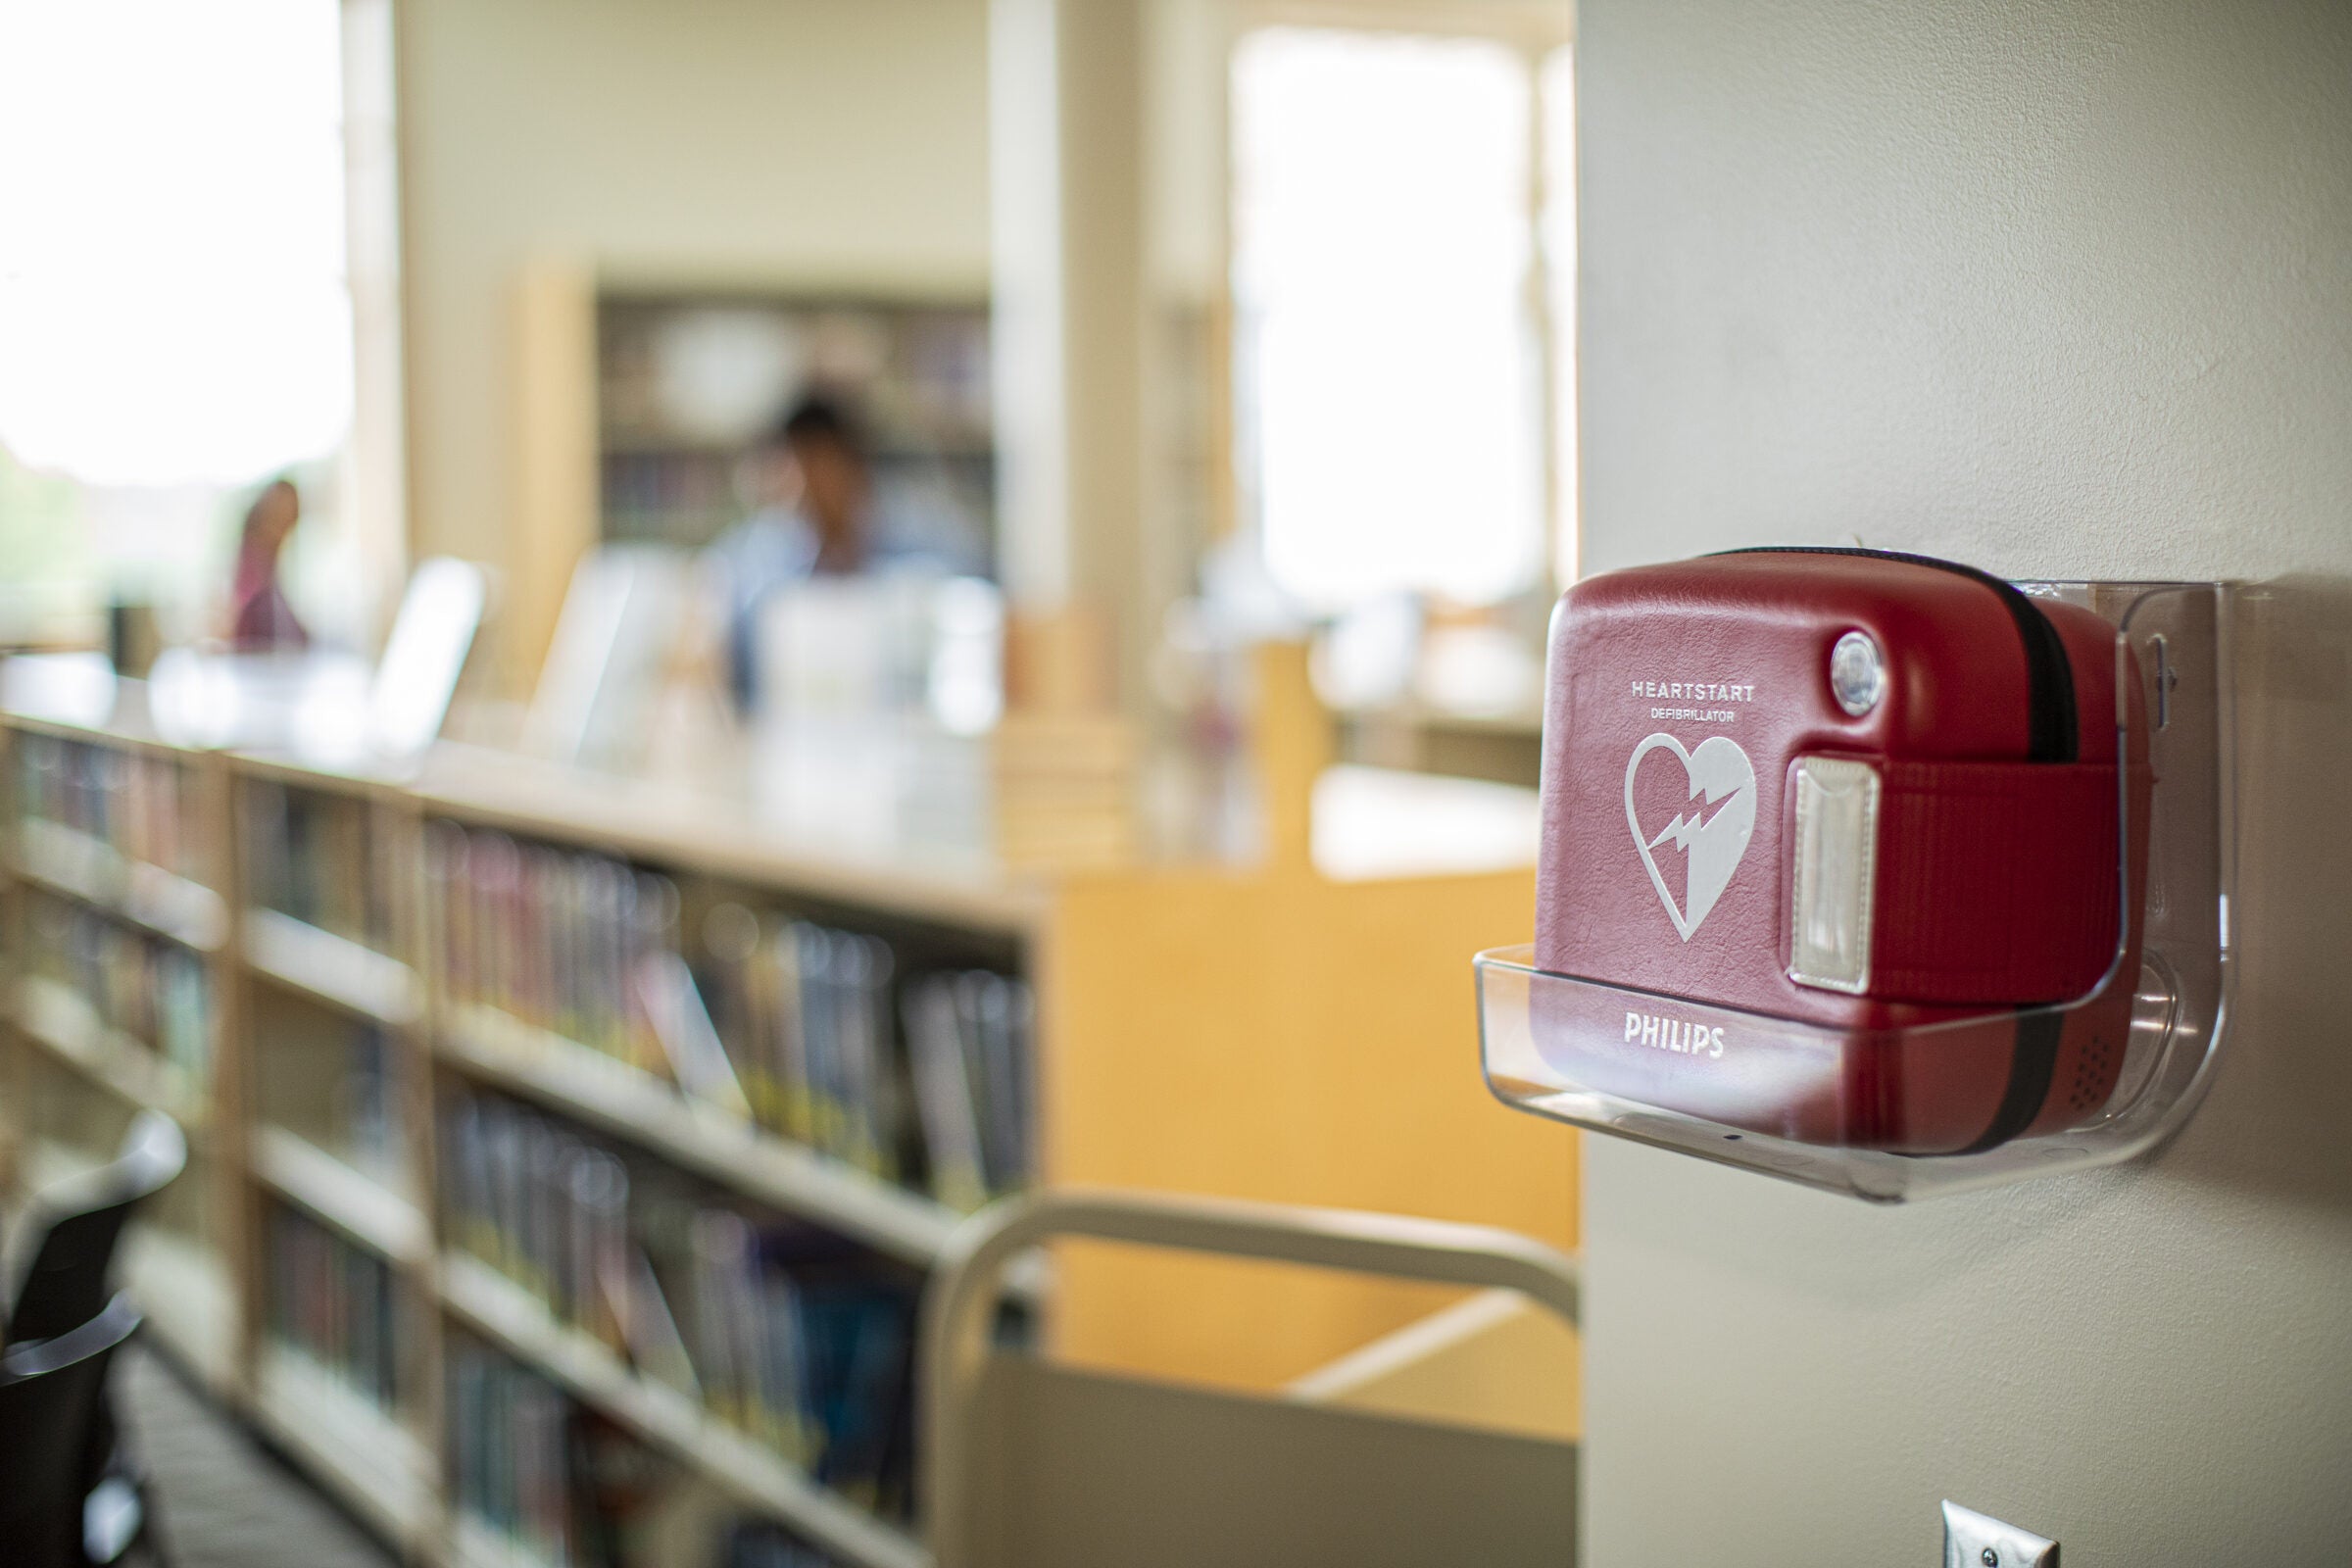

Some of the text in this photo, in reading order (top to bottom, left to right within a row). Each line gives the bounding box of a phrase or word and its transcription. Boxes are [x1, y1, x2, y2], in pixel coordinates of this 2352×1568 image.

[1631, 680, 1755, 702] HEARTSTART
[1650, 708, 1735, 722] DEFIBRILLATOR
[1624, 1011, 1725, 1058] PHILIPS
